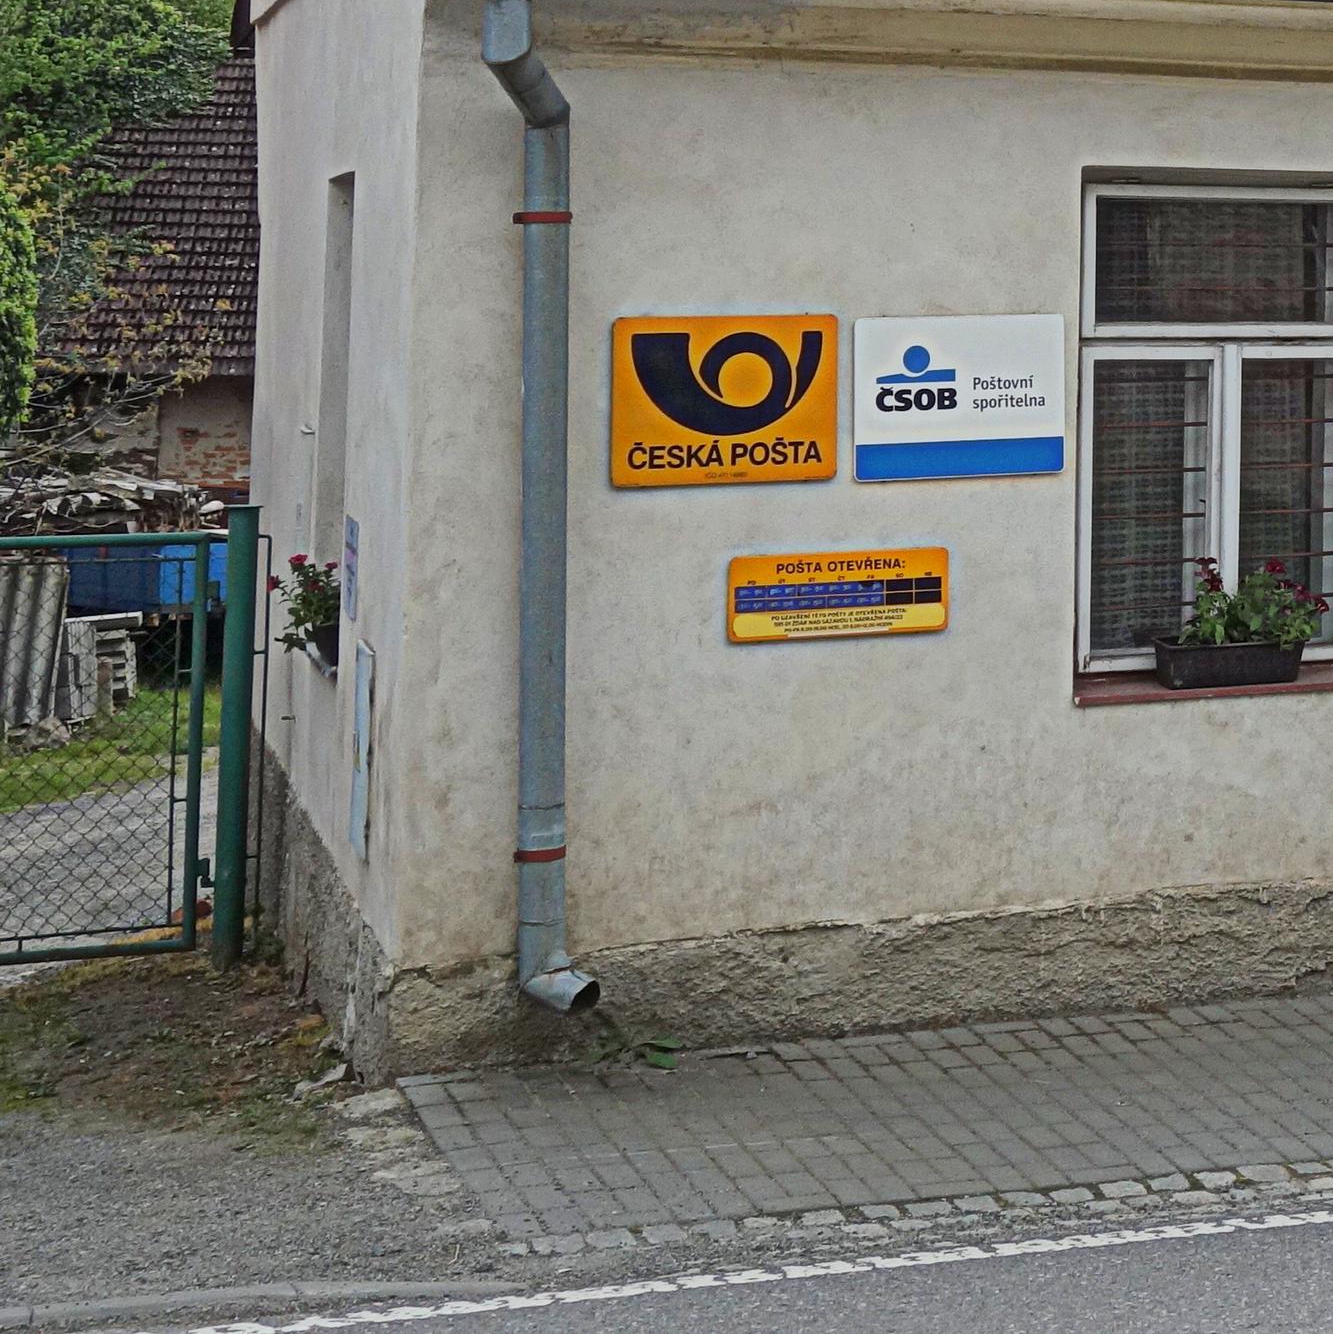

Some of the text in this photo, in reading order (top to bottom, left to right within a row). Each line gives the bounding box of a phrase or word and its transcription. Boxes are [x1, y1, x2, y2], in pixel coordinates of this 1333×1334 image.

[972, 374, 1035, 391] Poštovní
[875, 386, 958, 413] ČSOB
[972, 393, 1046, 412] spořitelna
[627, 437, 823, 470] ČESKÁ POŠTA
[776, 556, 906, 575] POŠTA OTEVŘENA:
